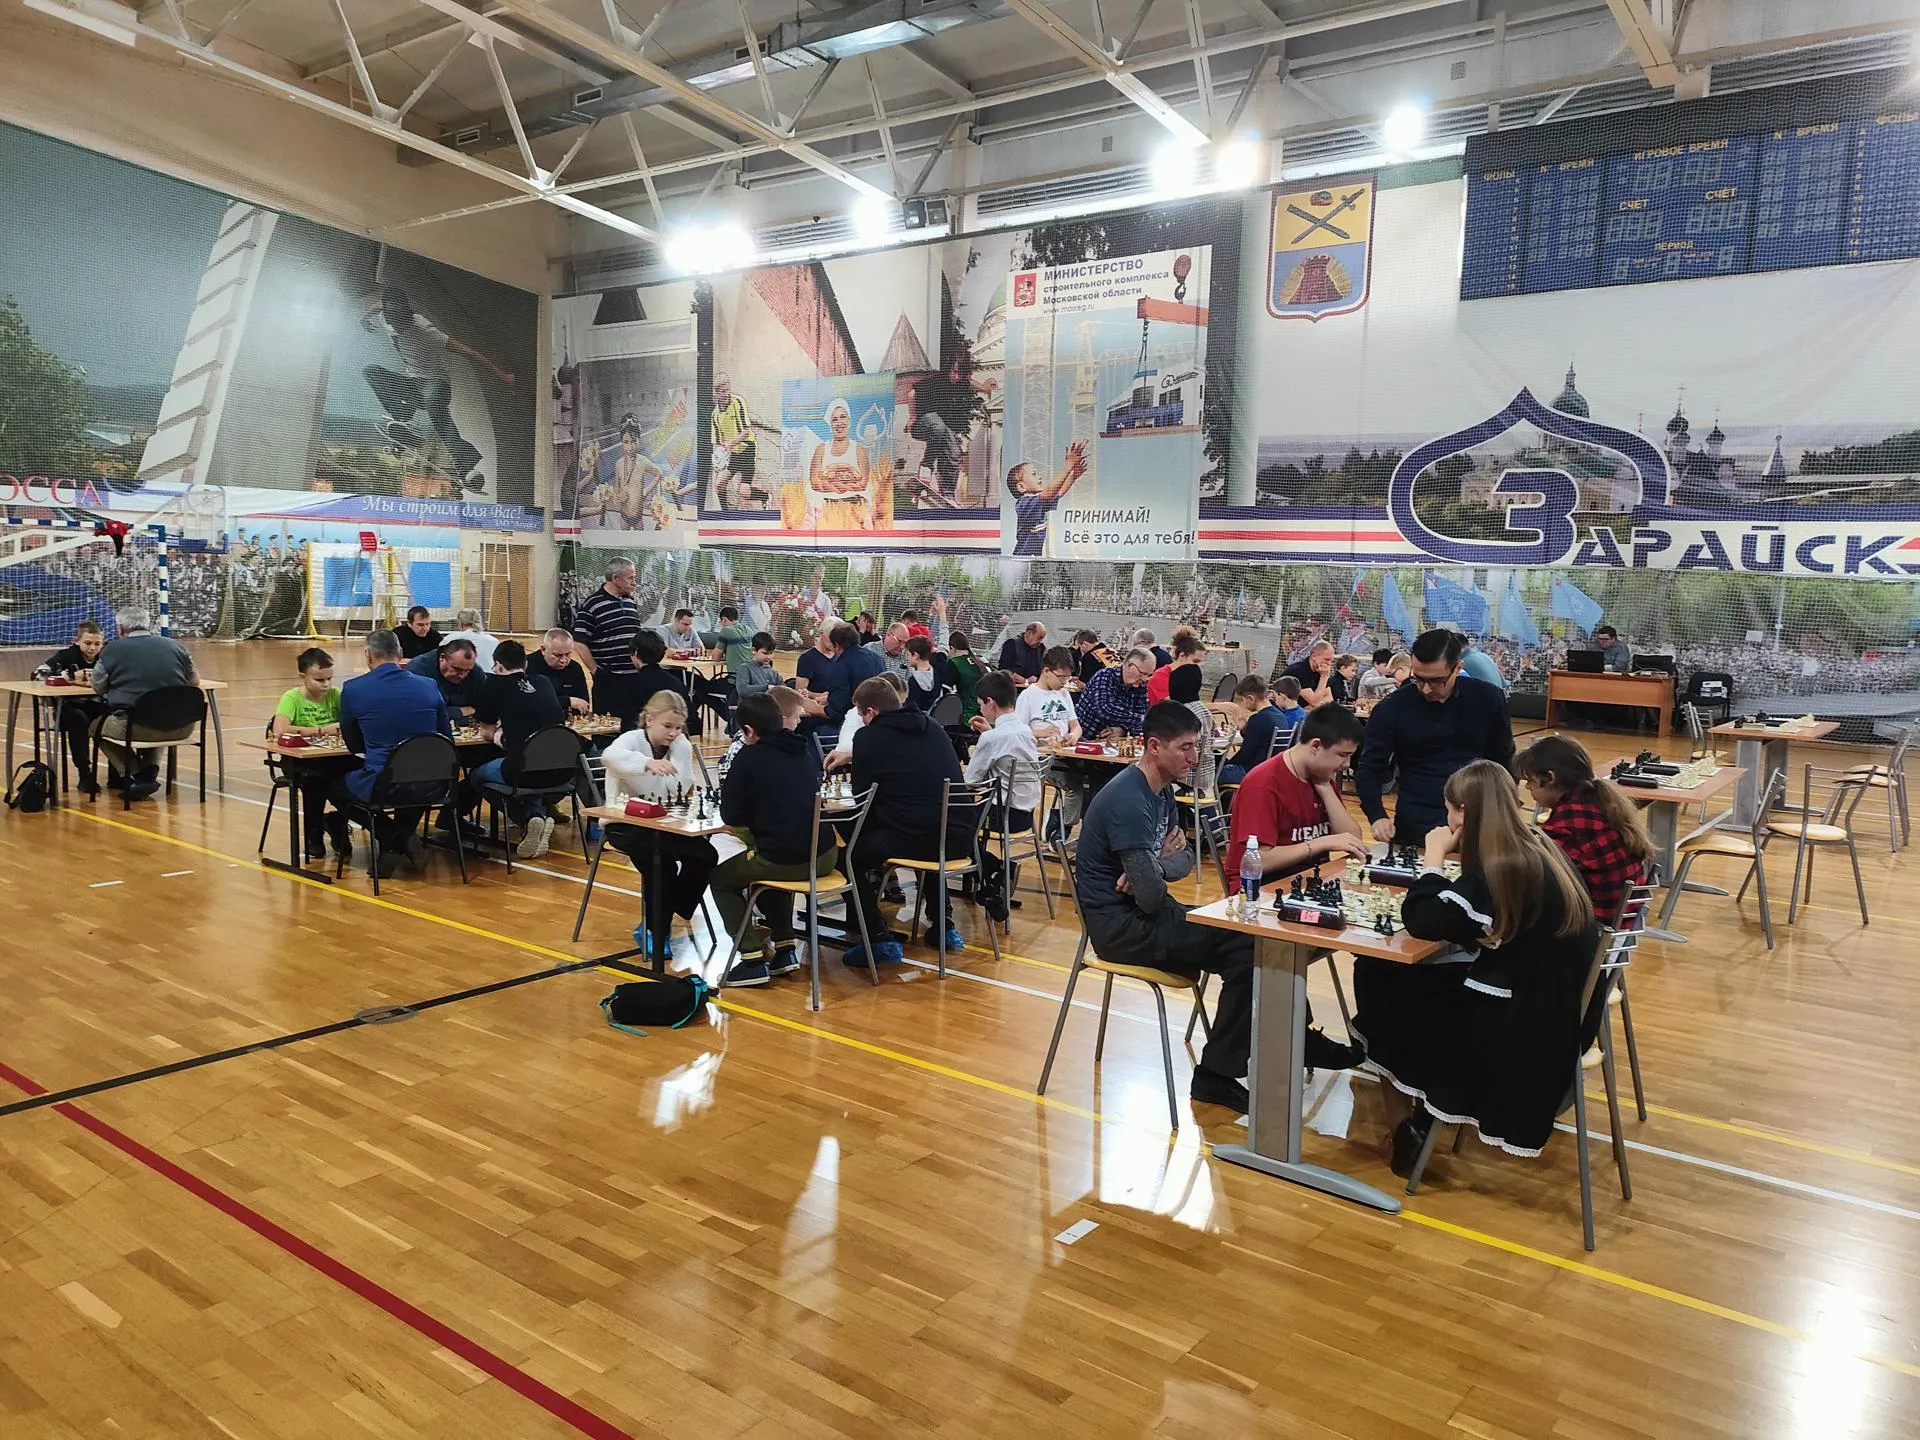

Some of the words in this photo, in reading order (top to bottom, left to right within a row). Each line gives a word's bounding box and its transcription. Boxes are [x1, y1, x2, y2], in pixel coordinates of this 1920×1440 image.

[1796, 123, 1839, 136] ВРЕМЯ
[1634, 145, 1684, 160] ИГРОВОЕ
[1689, 139, 1729, 153] ВРЕМЯ
[1705, 187, 1737, 200] СЧЕТ
[1619, 199, 1649, 210] СЧЕТ
[1655, 240, 1694, 250] ПЕРИОД
[1044, 258, 1144, 281] МИНИСТЕРСТВО
[1043, 279, 1112, 294] строительного
[1114, 270, 1169, 284] комплекса
[1043, 291, 1100, 305] Московской
[1102, 287, 1142, 298] области
[362, 495, 394, 512] Мы
[399, 501, 458, 518] строим
[462, 502, 487, 517] для
[490, 504, 521, 519] Вас!
[1064, 506, 1150, 523] ПРИНИМАЙ!
[1064, 530, 1090, 544] Всё
[1094, 533, 1120, 544] это
[1124, 533, 1149, 545] для
[1155, 530, 1195, 545] тебя!
